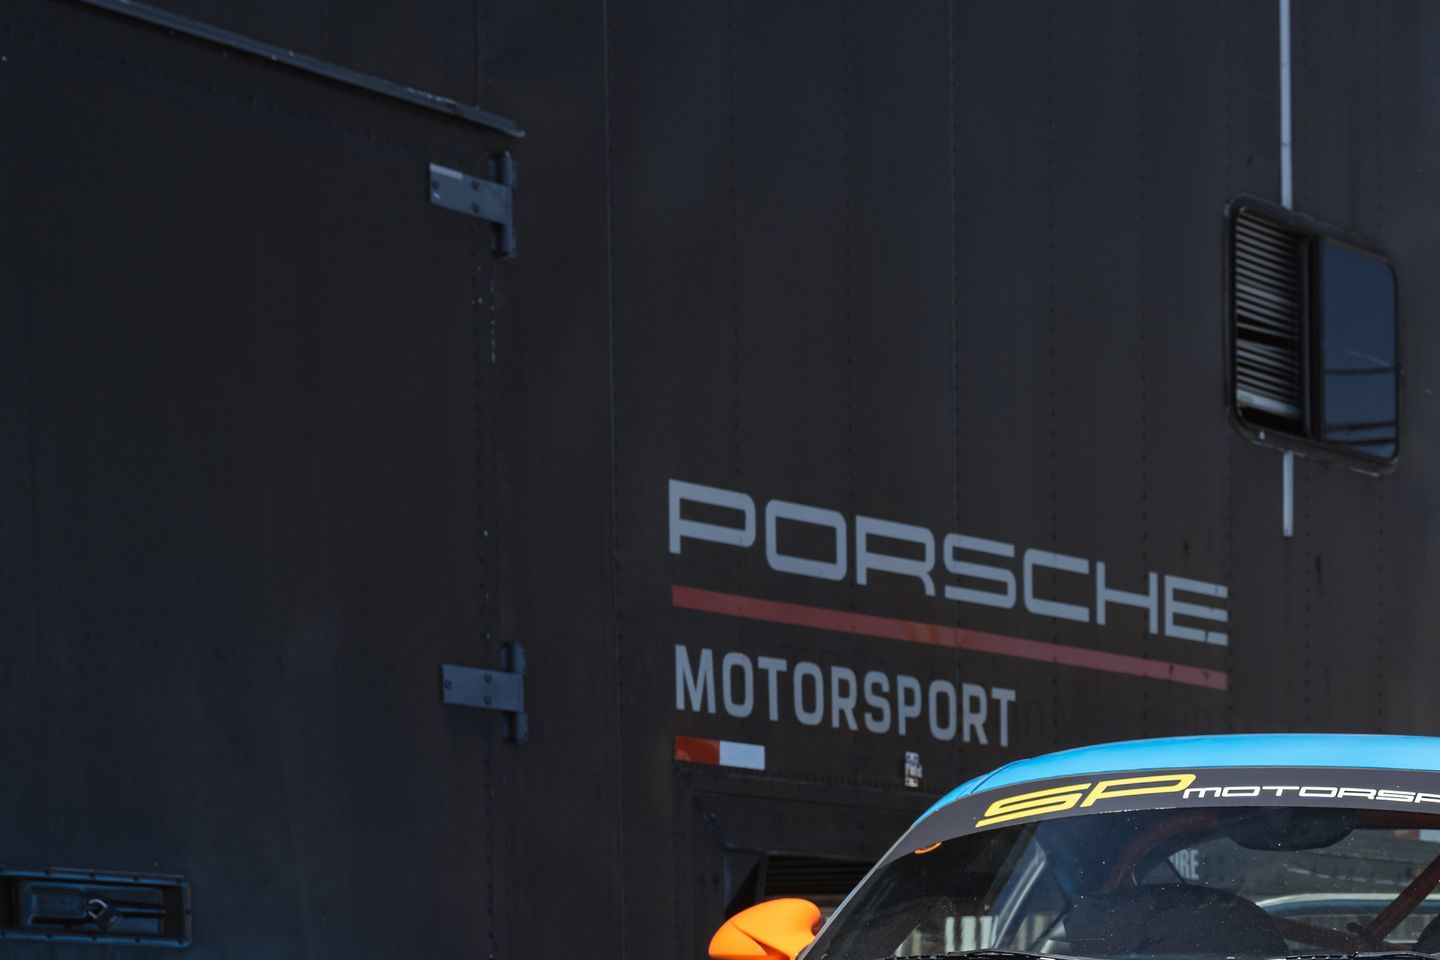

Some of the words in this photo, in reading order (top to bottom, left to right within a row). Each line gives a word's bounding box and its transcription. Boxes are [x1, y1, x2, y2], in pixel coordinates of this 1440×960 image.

[668, 479, 1228, 646] PORSCHE
[675, 644, 1016, 747] MOTORSPORT
[975, 773, 1196, 828] SP
